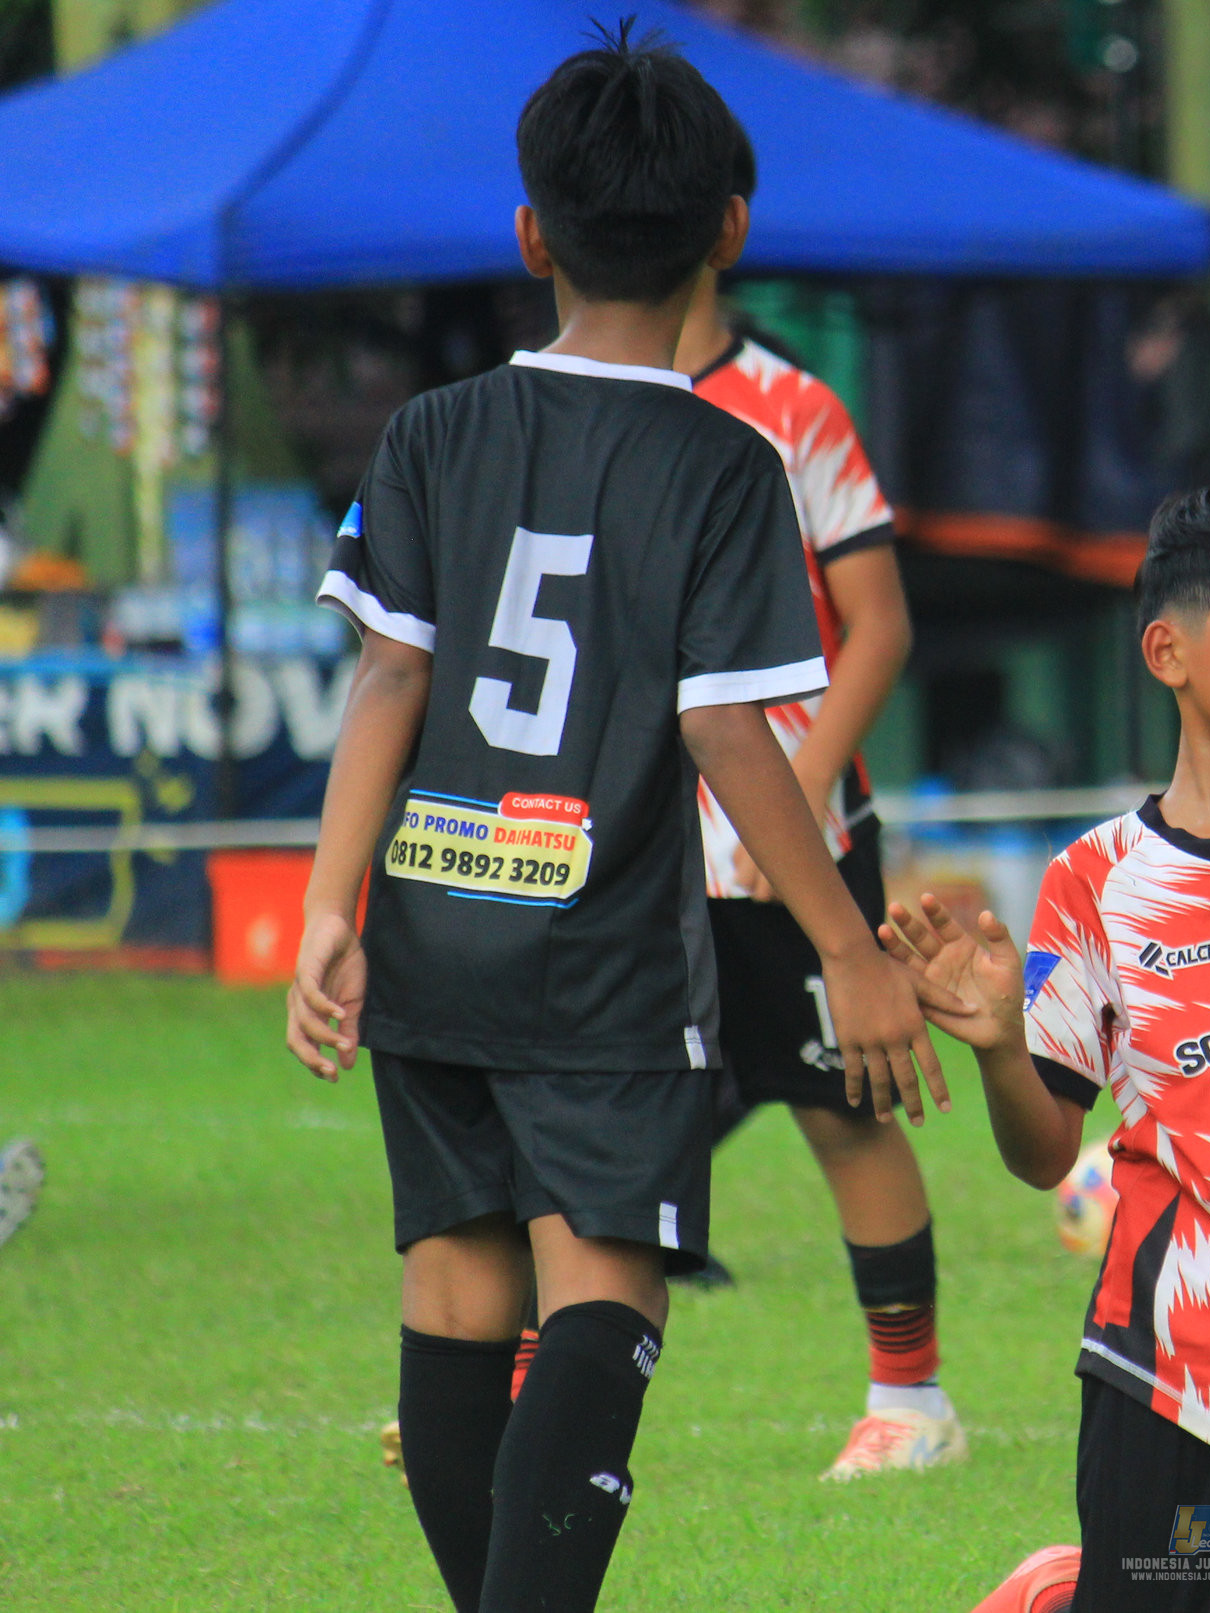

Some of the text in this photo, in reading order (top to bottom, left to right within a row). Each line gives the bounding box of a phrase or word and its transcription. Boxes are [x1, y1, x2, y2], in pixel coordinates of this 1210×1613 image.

[468, 525, 595, 757] 5
[512, 796, 582, 815] CONTACT US
[424, 814, 489, 841] PROMO
[493, 826, 576, 852] DAIHATSU
[391, 839, 570, 887] 0812 9892 3209
